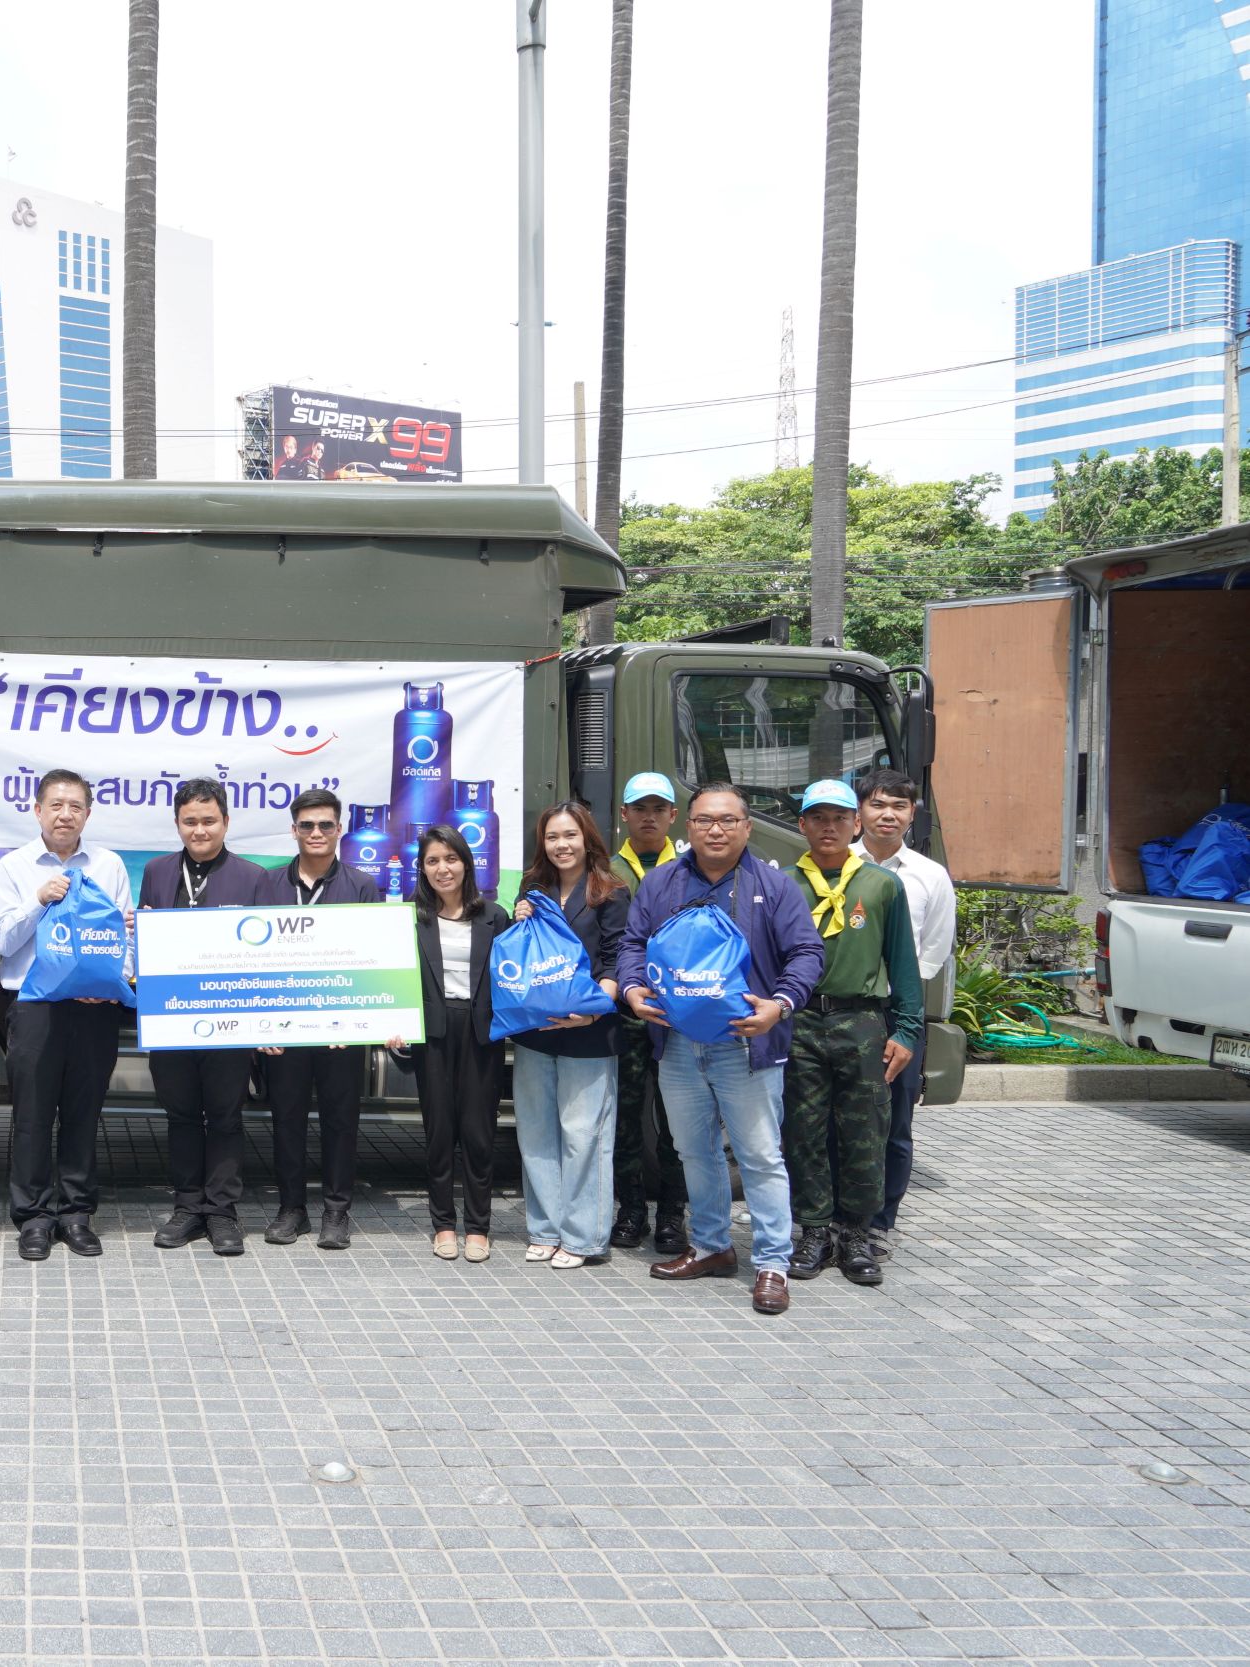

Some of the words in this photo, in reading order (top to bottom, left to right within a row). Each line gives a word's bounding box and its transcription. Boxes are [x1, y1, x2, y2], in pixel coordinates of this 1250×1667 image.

[290, 407, 366, 432] SUPER
[320, 428, 364, 442] POWER
[364, 416, 390, 445] X
[389, 416, 452, 463] 99
[277, 916, 315, 934] WP
[277, 935, 315, 944] ENERGY
[217, 1020, 239, 1031] WP
